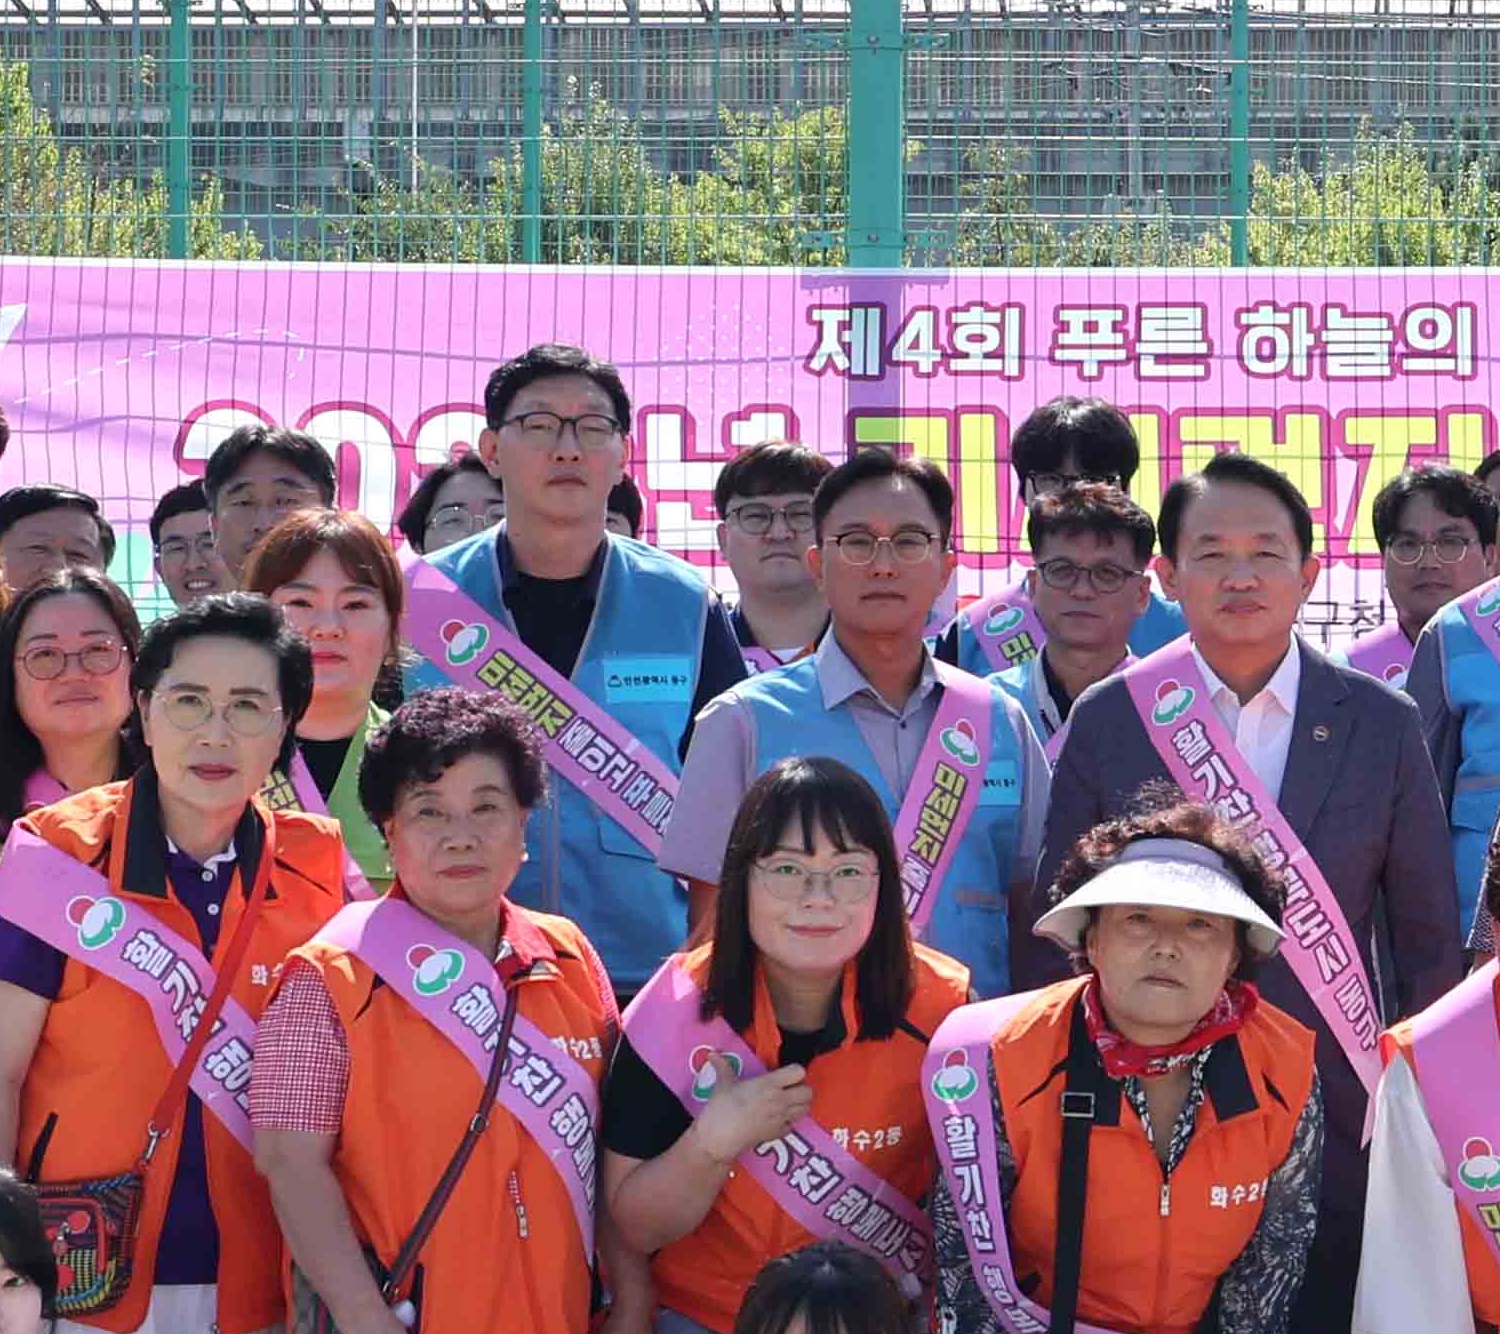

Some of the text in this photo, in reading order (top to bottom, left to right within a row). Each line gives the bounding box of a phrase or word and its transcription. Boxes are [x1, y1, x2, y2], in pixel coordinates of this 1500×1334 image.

[805, 302, 1025, 380] 제4회
[1053, 302, 1212, 380] 푸른
[1236, 301, 1477, 380] 하늘의
[555, 716, 637, 794] 줄이고
[908, 760, 968, 867] 미세먼지
[1333, 973, 1381, 1053] 동구
[943, 1114, 998, 1255] 활기찬
